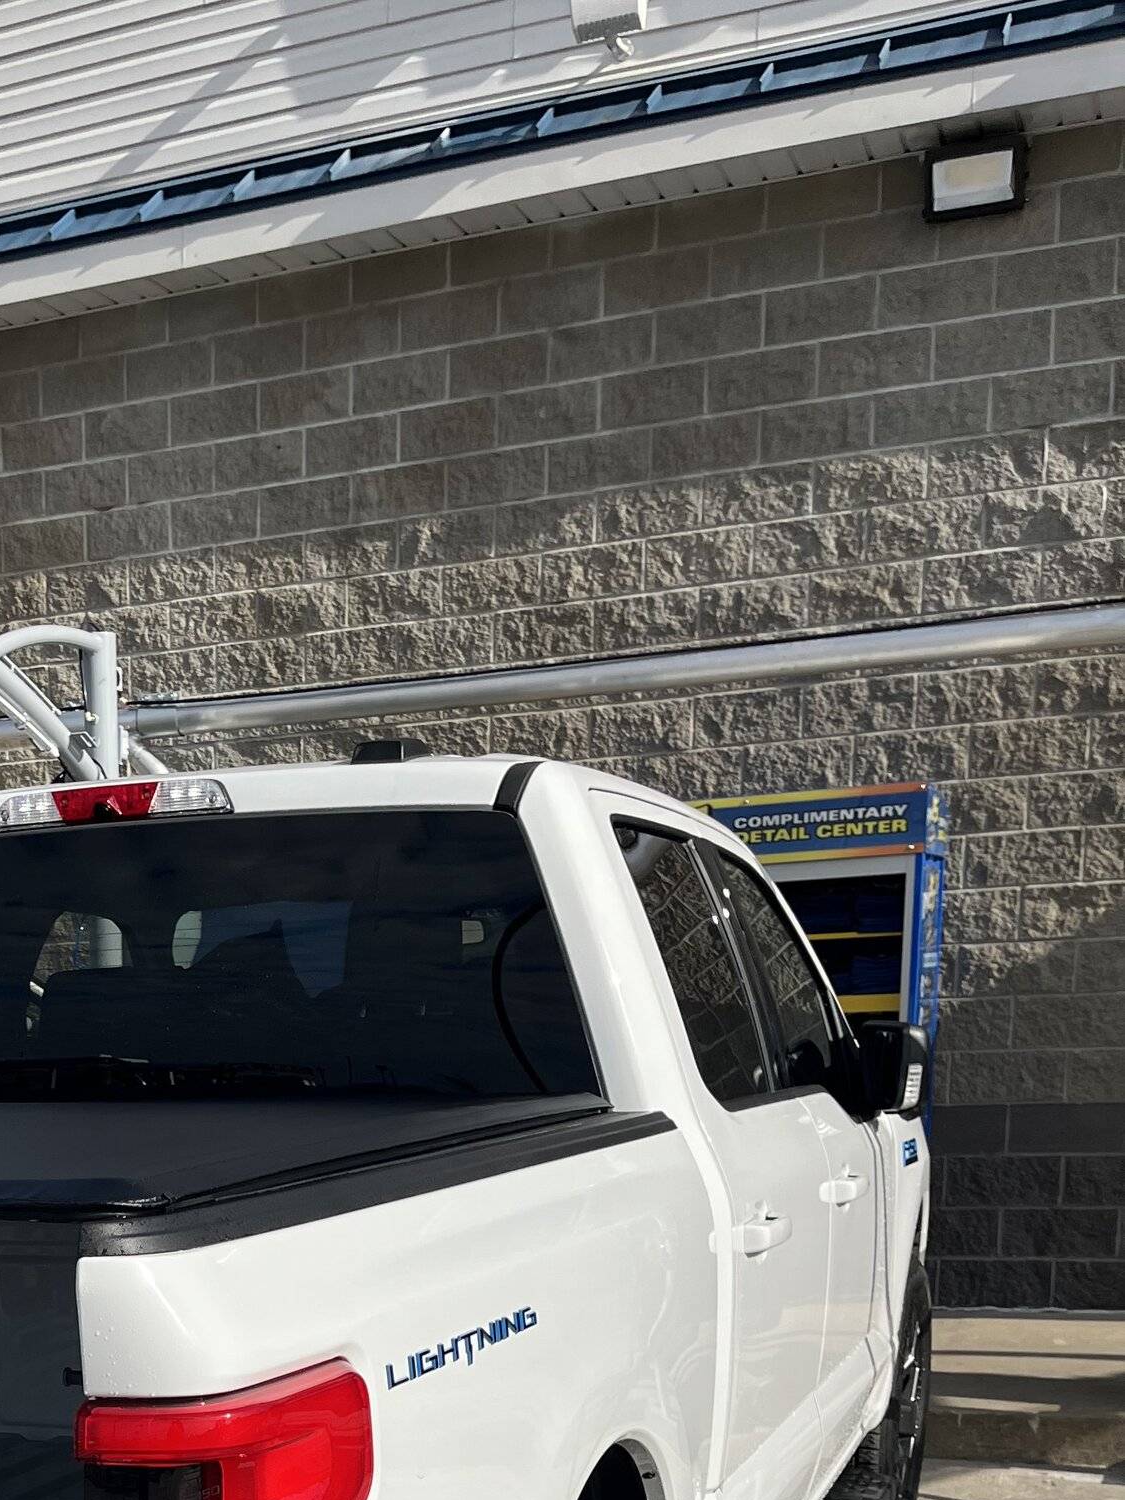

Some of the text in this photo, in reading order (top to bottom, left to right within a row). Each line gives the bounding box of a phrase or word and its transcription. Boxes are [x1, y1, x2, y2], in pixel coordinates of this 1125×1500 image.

[734, 804, 907, 829] COMPLIMENTARY
[736, 819, 907, 844] DETAIL CENTER
[385, 1306, 537, 1390] LIGHTNING
